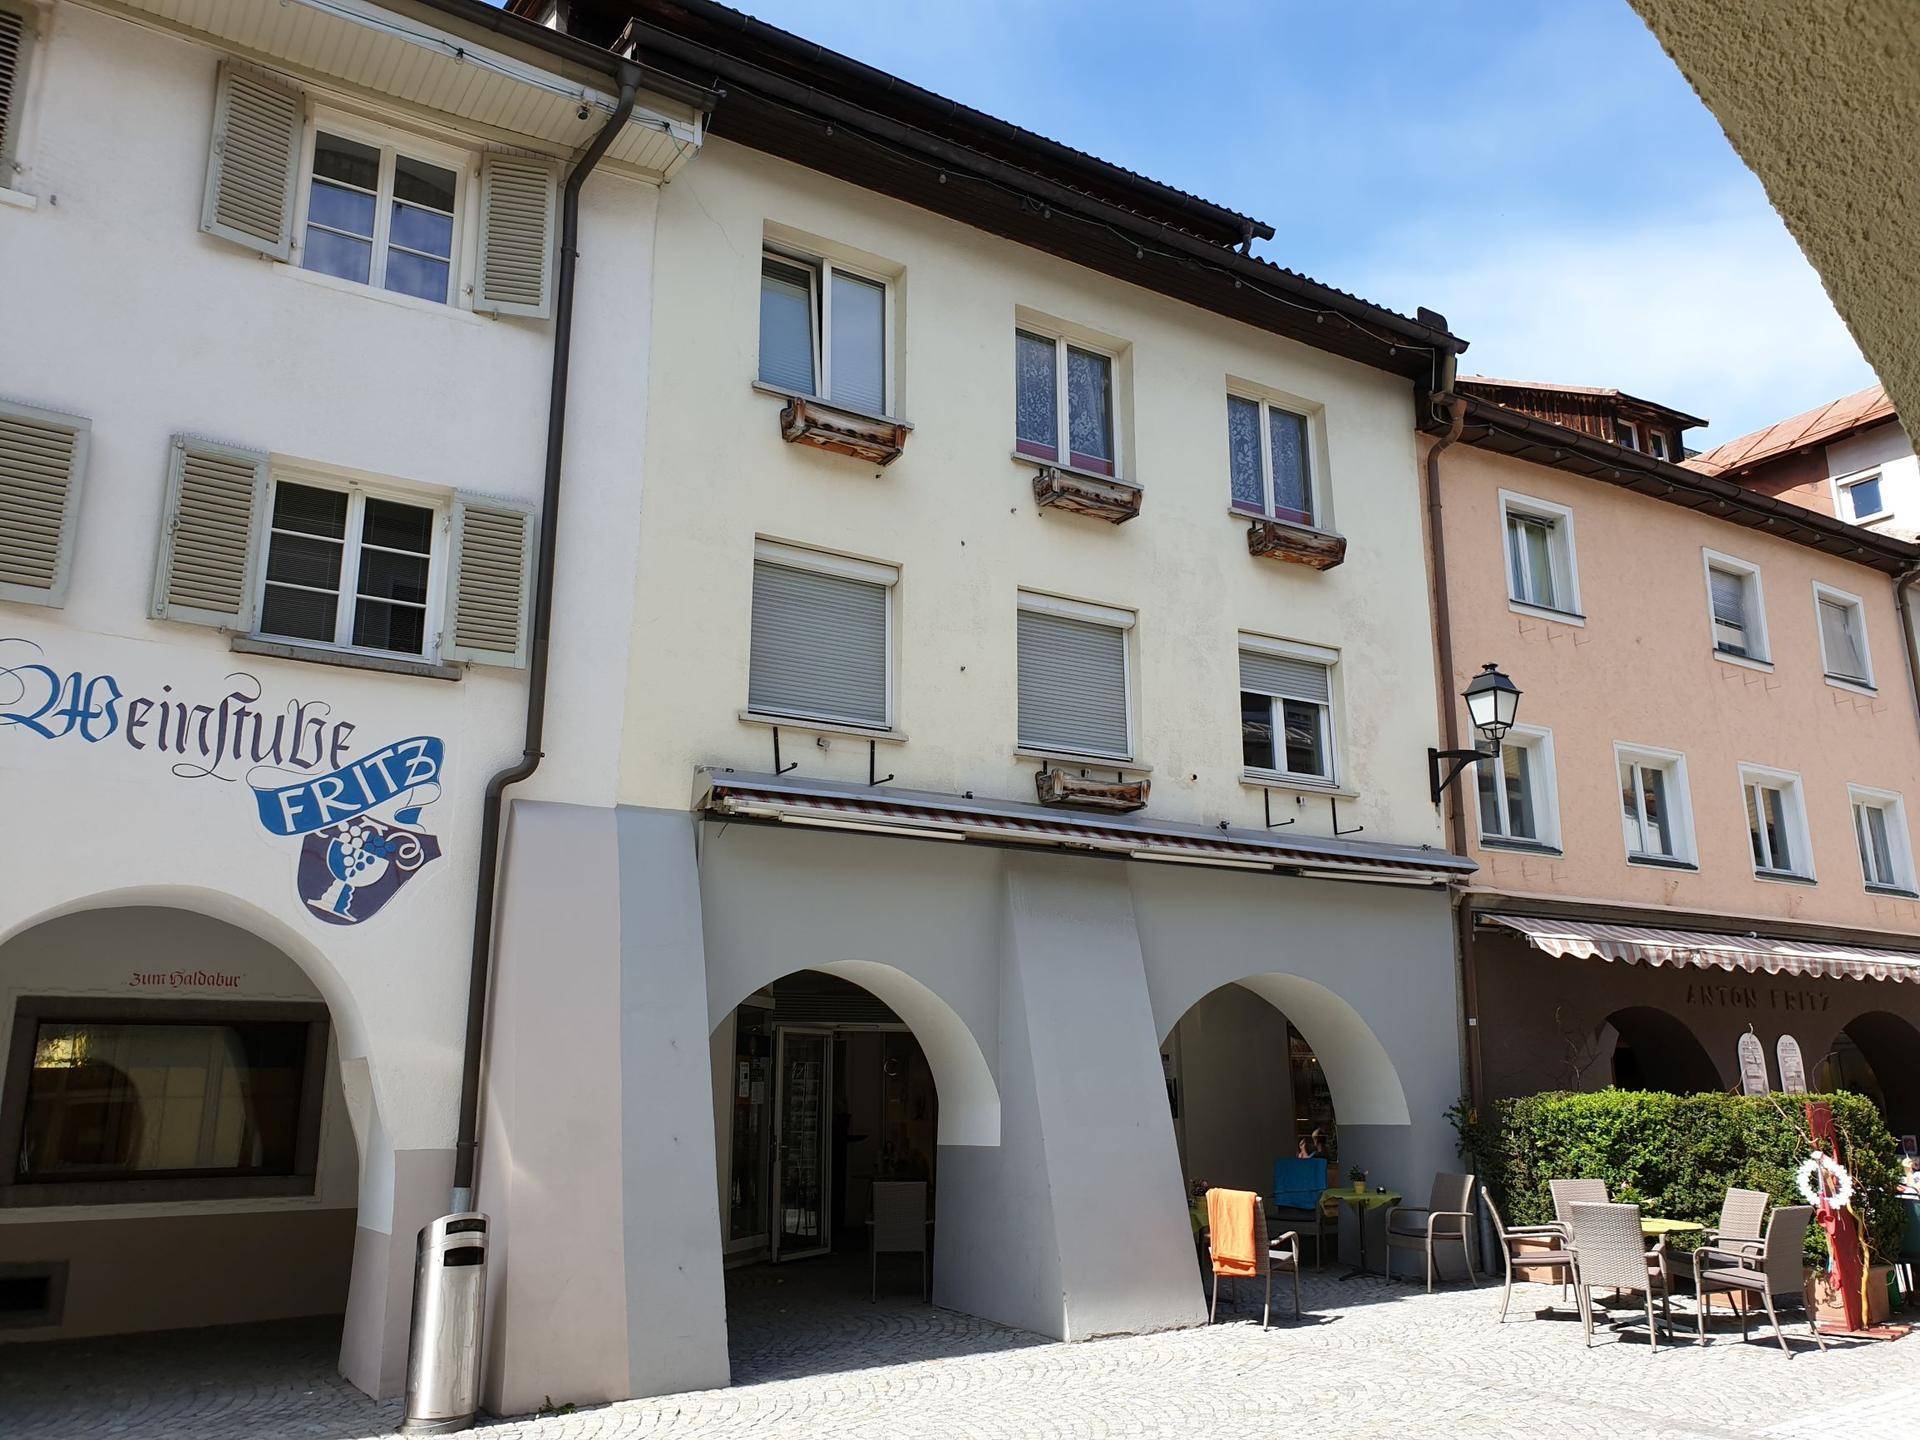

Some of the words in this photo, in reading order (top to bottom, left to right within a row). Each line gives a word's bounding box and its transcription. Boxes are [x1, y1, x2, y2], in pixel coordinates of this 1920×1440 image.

[277, 739, 437, 833] FRITZ
[1686, 984, 1757, 1008] ANTON
[1770, 989, 1830, 1011] FRITZ
